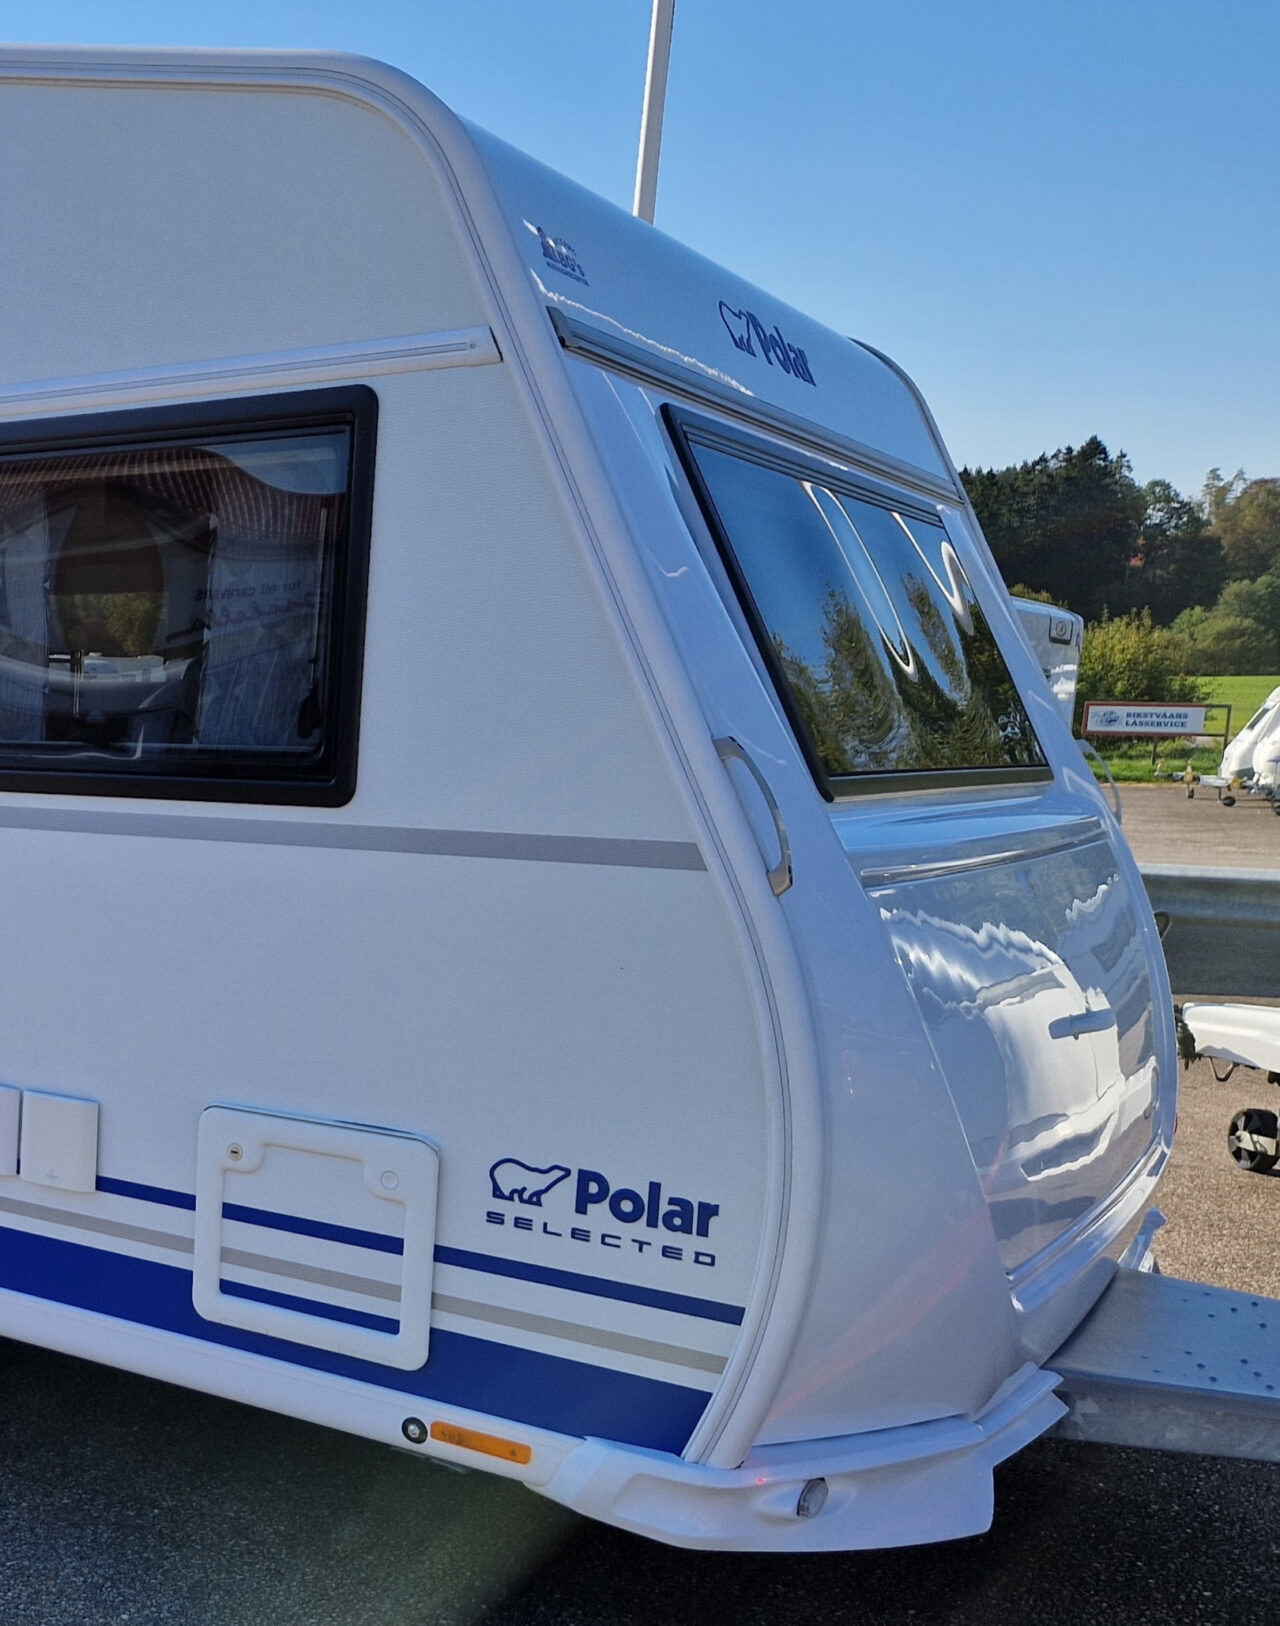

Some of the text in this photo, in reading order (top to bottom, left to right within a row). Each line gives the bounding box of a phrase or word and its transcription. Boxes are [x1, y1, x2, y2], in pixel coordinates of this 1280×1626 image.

[746, 311, 817, 387] Polar
[575, 1168, 720, 1238] Polar
[486, 1211, 716, 1267] SELECTED
